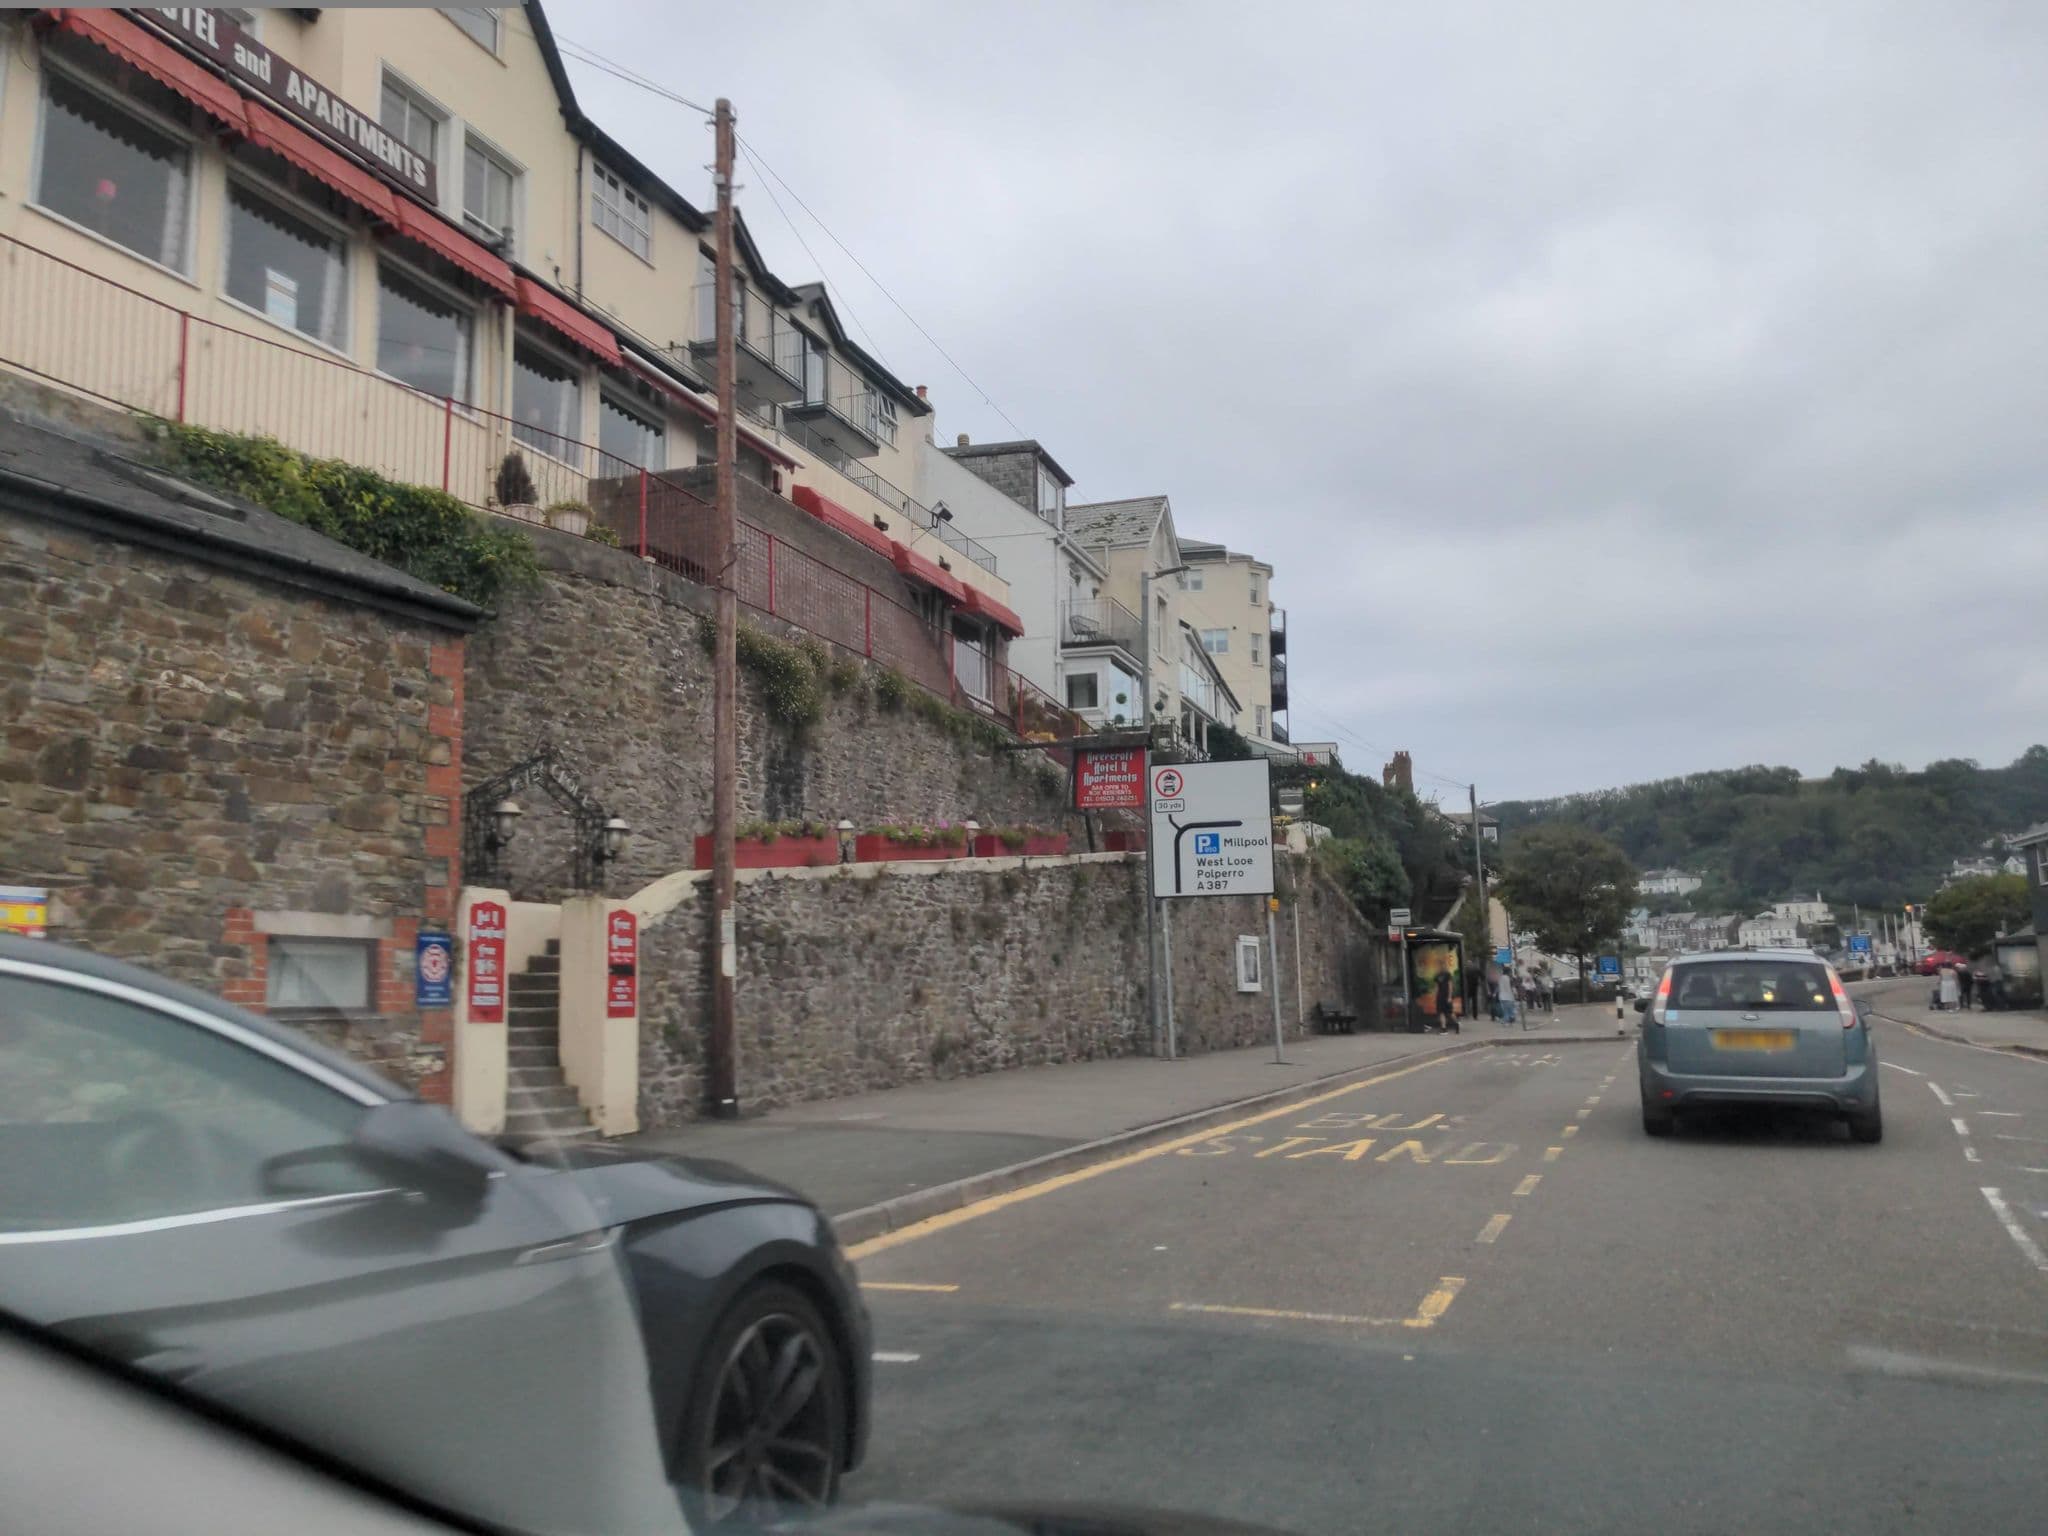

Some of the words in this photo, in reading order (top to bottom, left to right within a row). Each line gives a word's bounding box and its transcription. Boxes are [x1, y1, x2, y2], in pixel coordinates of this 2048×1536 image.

[233, 42, 272, 85] and
[286, 70, 427, 188] APARTMENTS
[1083, 772, 1138, 786] Apartments
[1198, 835, 1211, 853] P
[1224, 837, 1268, 848] Millpool
[1196, 857, 1224, 867] West
[1227, 857, 1253, 866] Looe
[1197, 869, 1244, 880] Polperro
[1175, 1136, 1519, 1163] STAND
